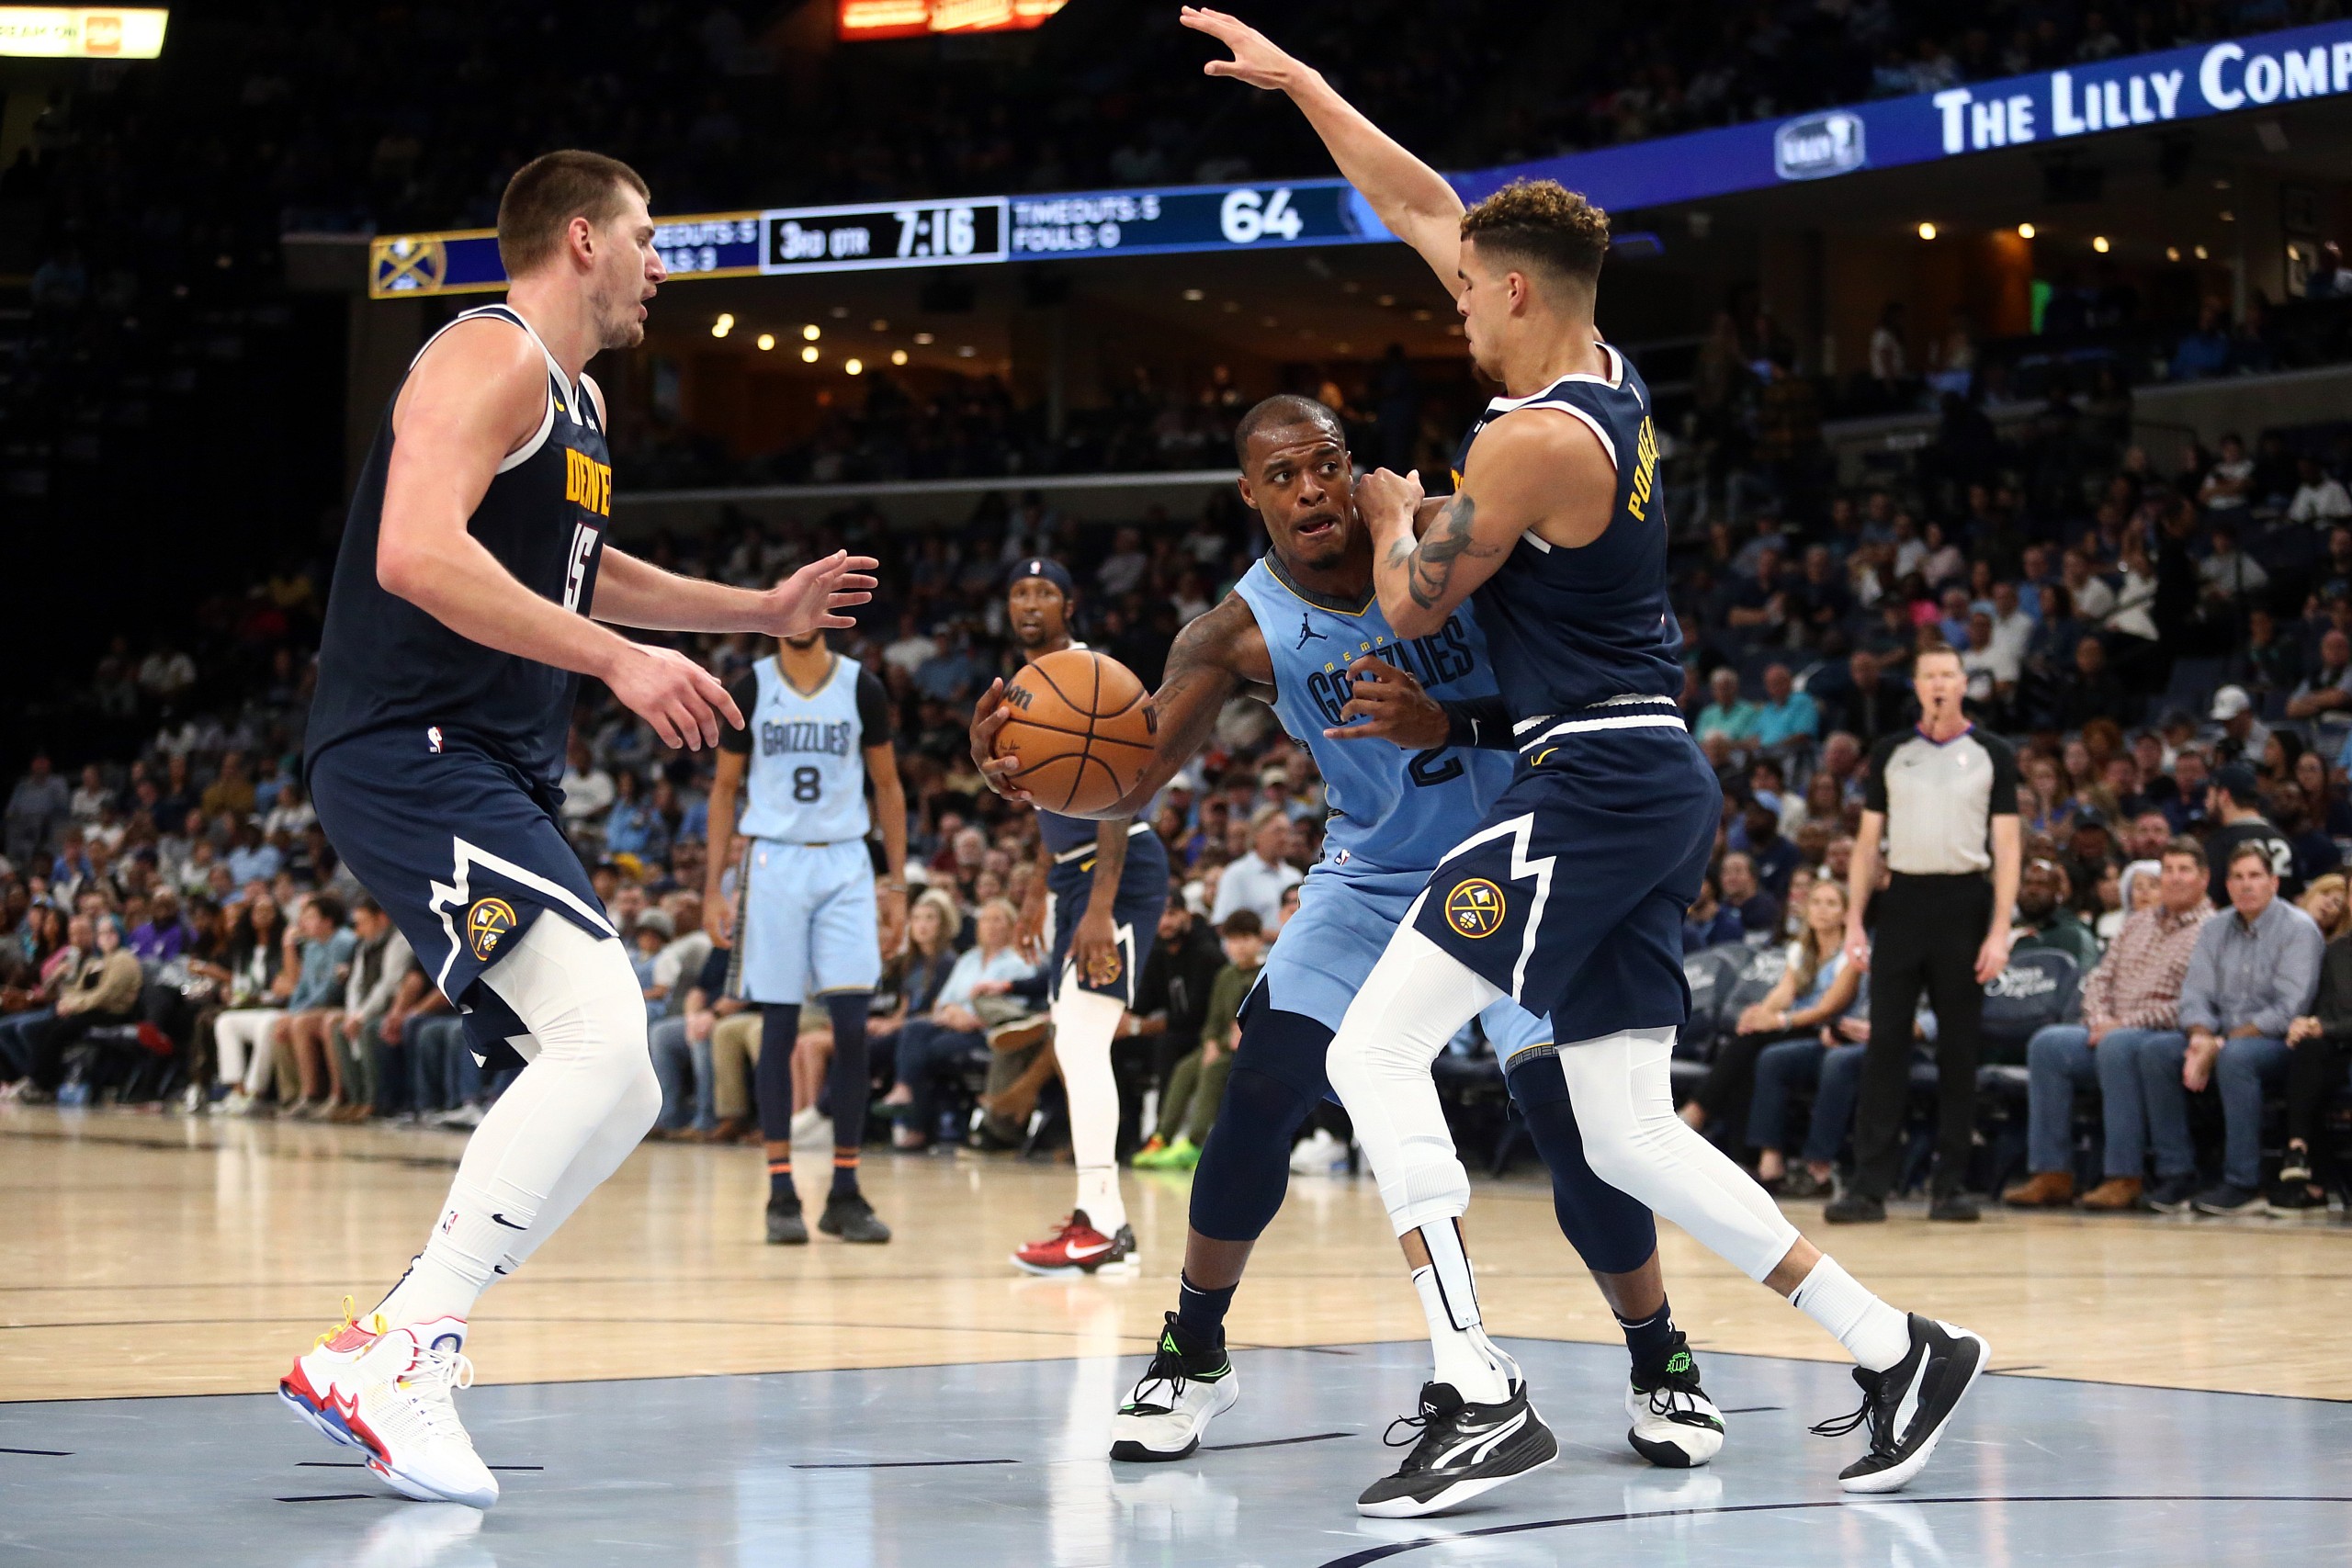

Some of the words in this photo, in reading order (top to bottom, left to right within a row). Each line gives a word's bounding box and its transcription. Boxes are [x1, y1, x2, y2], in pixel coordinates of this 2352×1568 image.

[1933, 87, 2036, 155] THE
[2051, 69, 2184, 137] LILLY
[894, 208, 976, 258] 7:16
[1220, 186, 1304, 244] 64
[565, 447, 612, 517] DENVE
[563, 522, 600, 614] 15
[1324, 631, 1400, 674] MEMP
[762, 720, 851, 757] GRIZZLIES
[793, 765, 821, 805] 8
